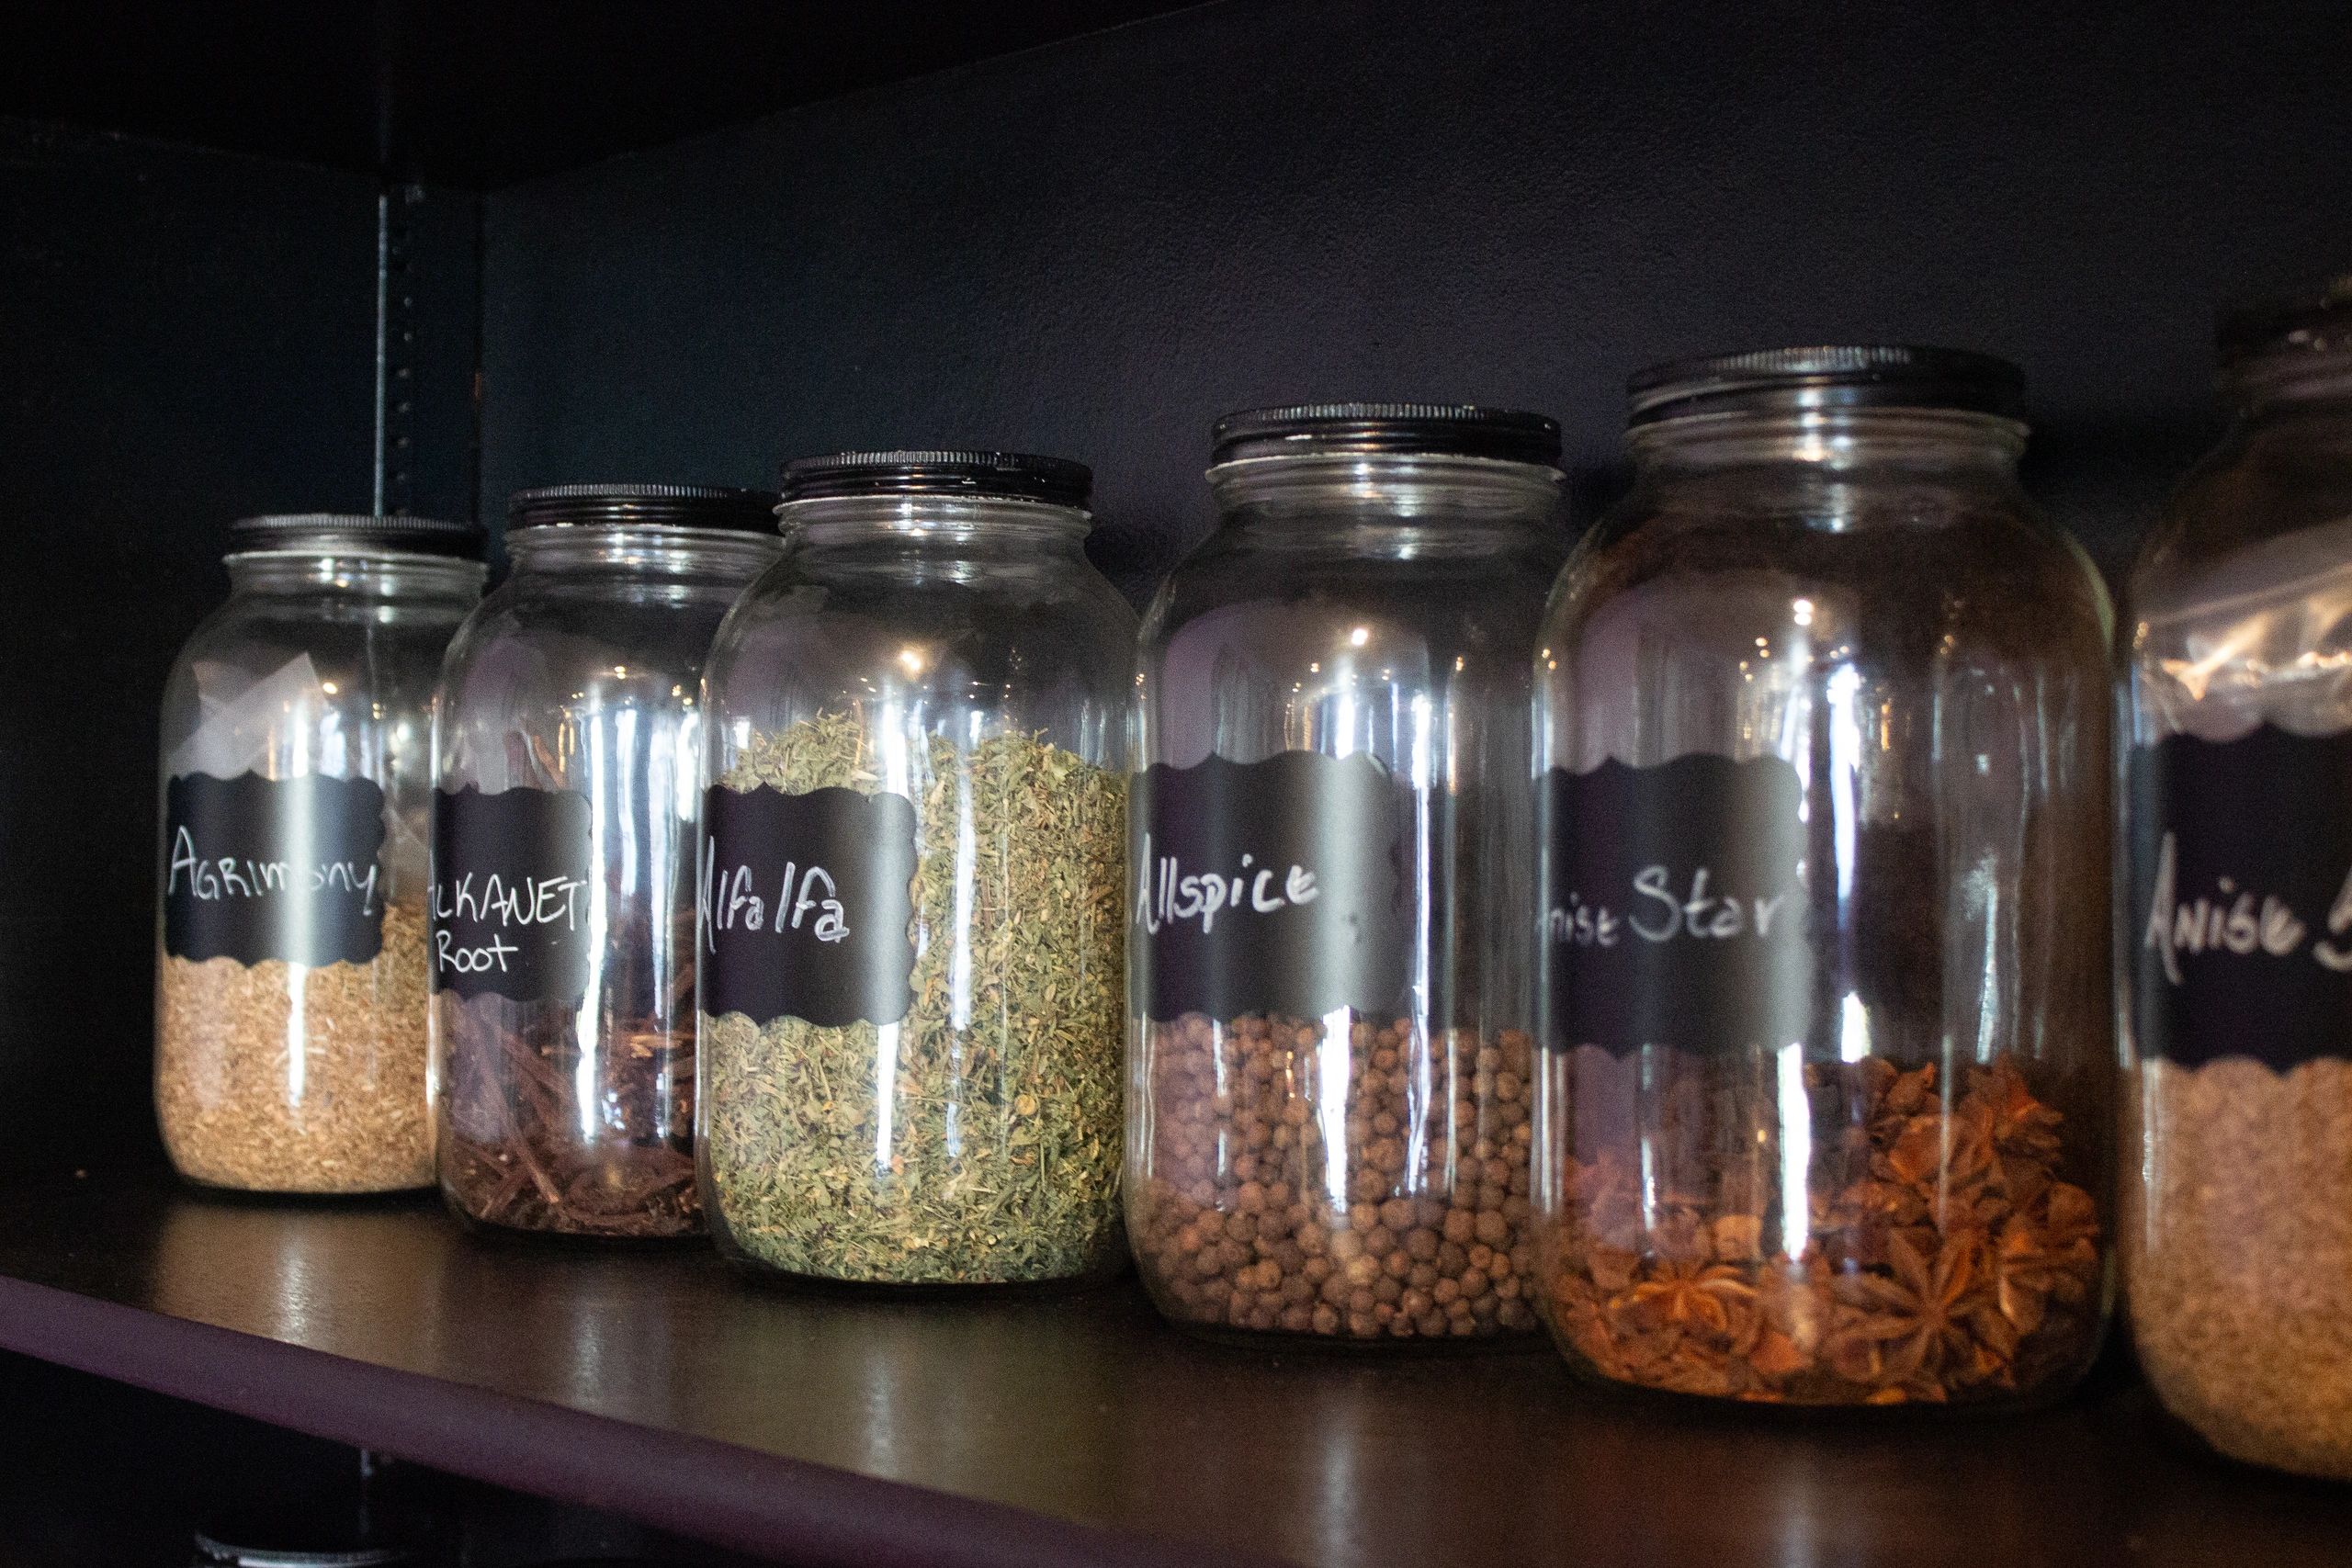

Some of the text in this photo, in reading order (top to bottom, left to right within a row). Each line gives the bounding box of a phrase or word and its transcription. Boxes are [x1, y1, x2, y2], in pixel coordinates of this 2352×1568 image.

[1136, 832, 1319, 935] Allspice
[1535, 863, 1786, 947] nise Star
[435, 930, 519, 973] Root
